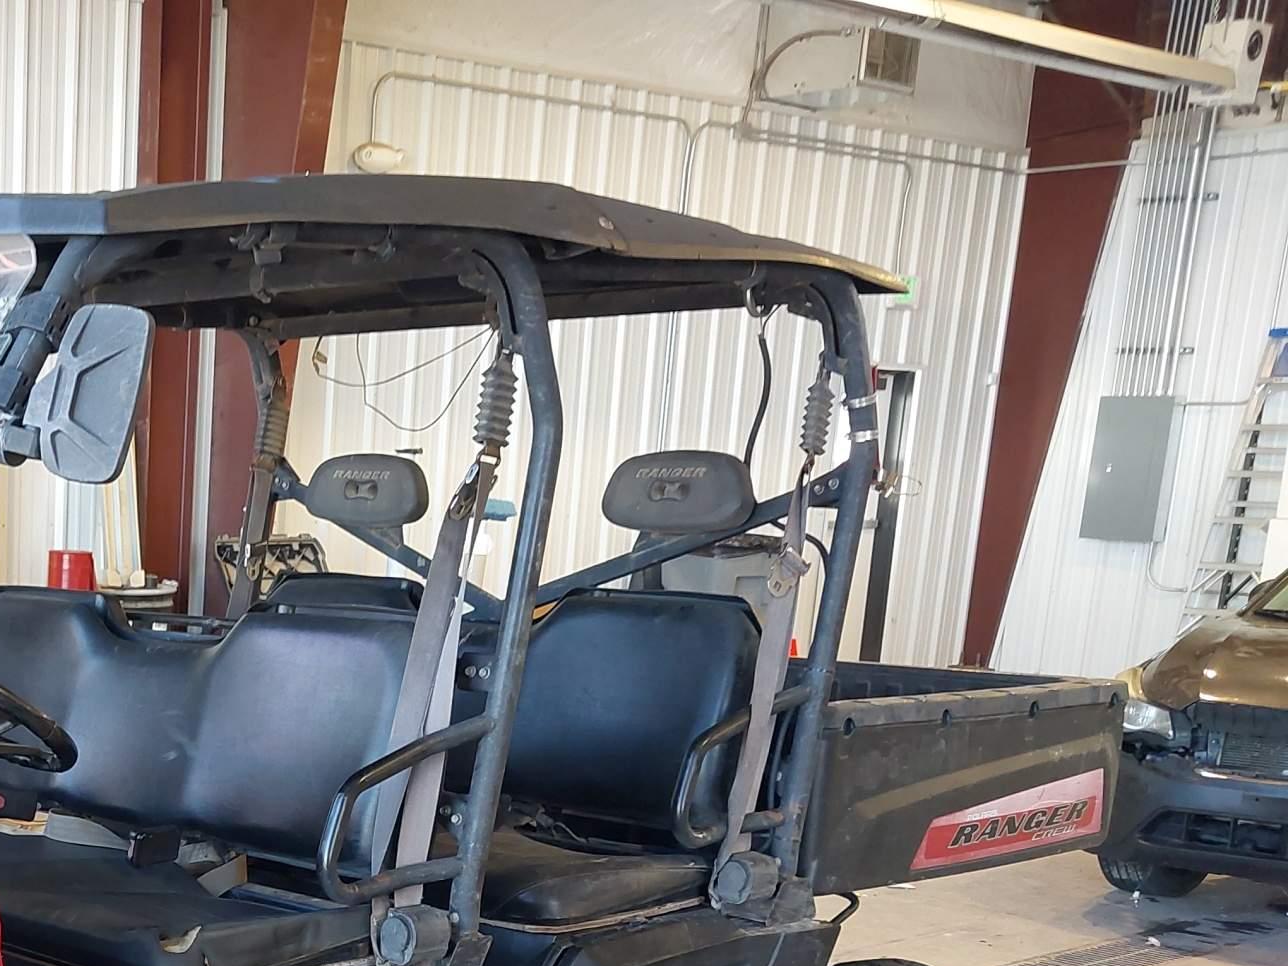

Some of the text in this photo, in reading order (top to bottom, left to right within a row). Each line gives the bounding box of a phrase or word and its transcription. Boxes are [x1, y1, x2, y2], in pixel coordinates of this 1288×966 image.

[332, 469, 391, 480] RANGER
[635, 466, 707, 479] RANGER
[947, 799, 1089, 849] RANGER
